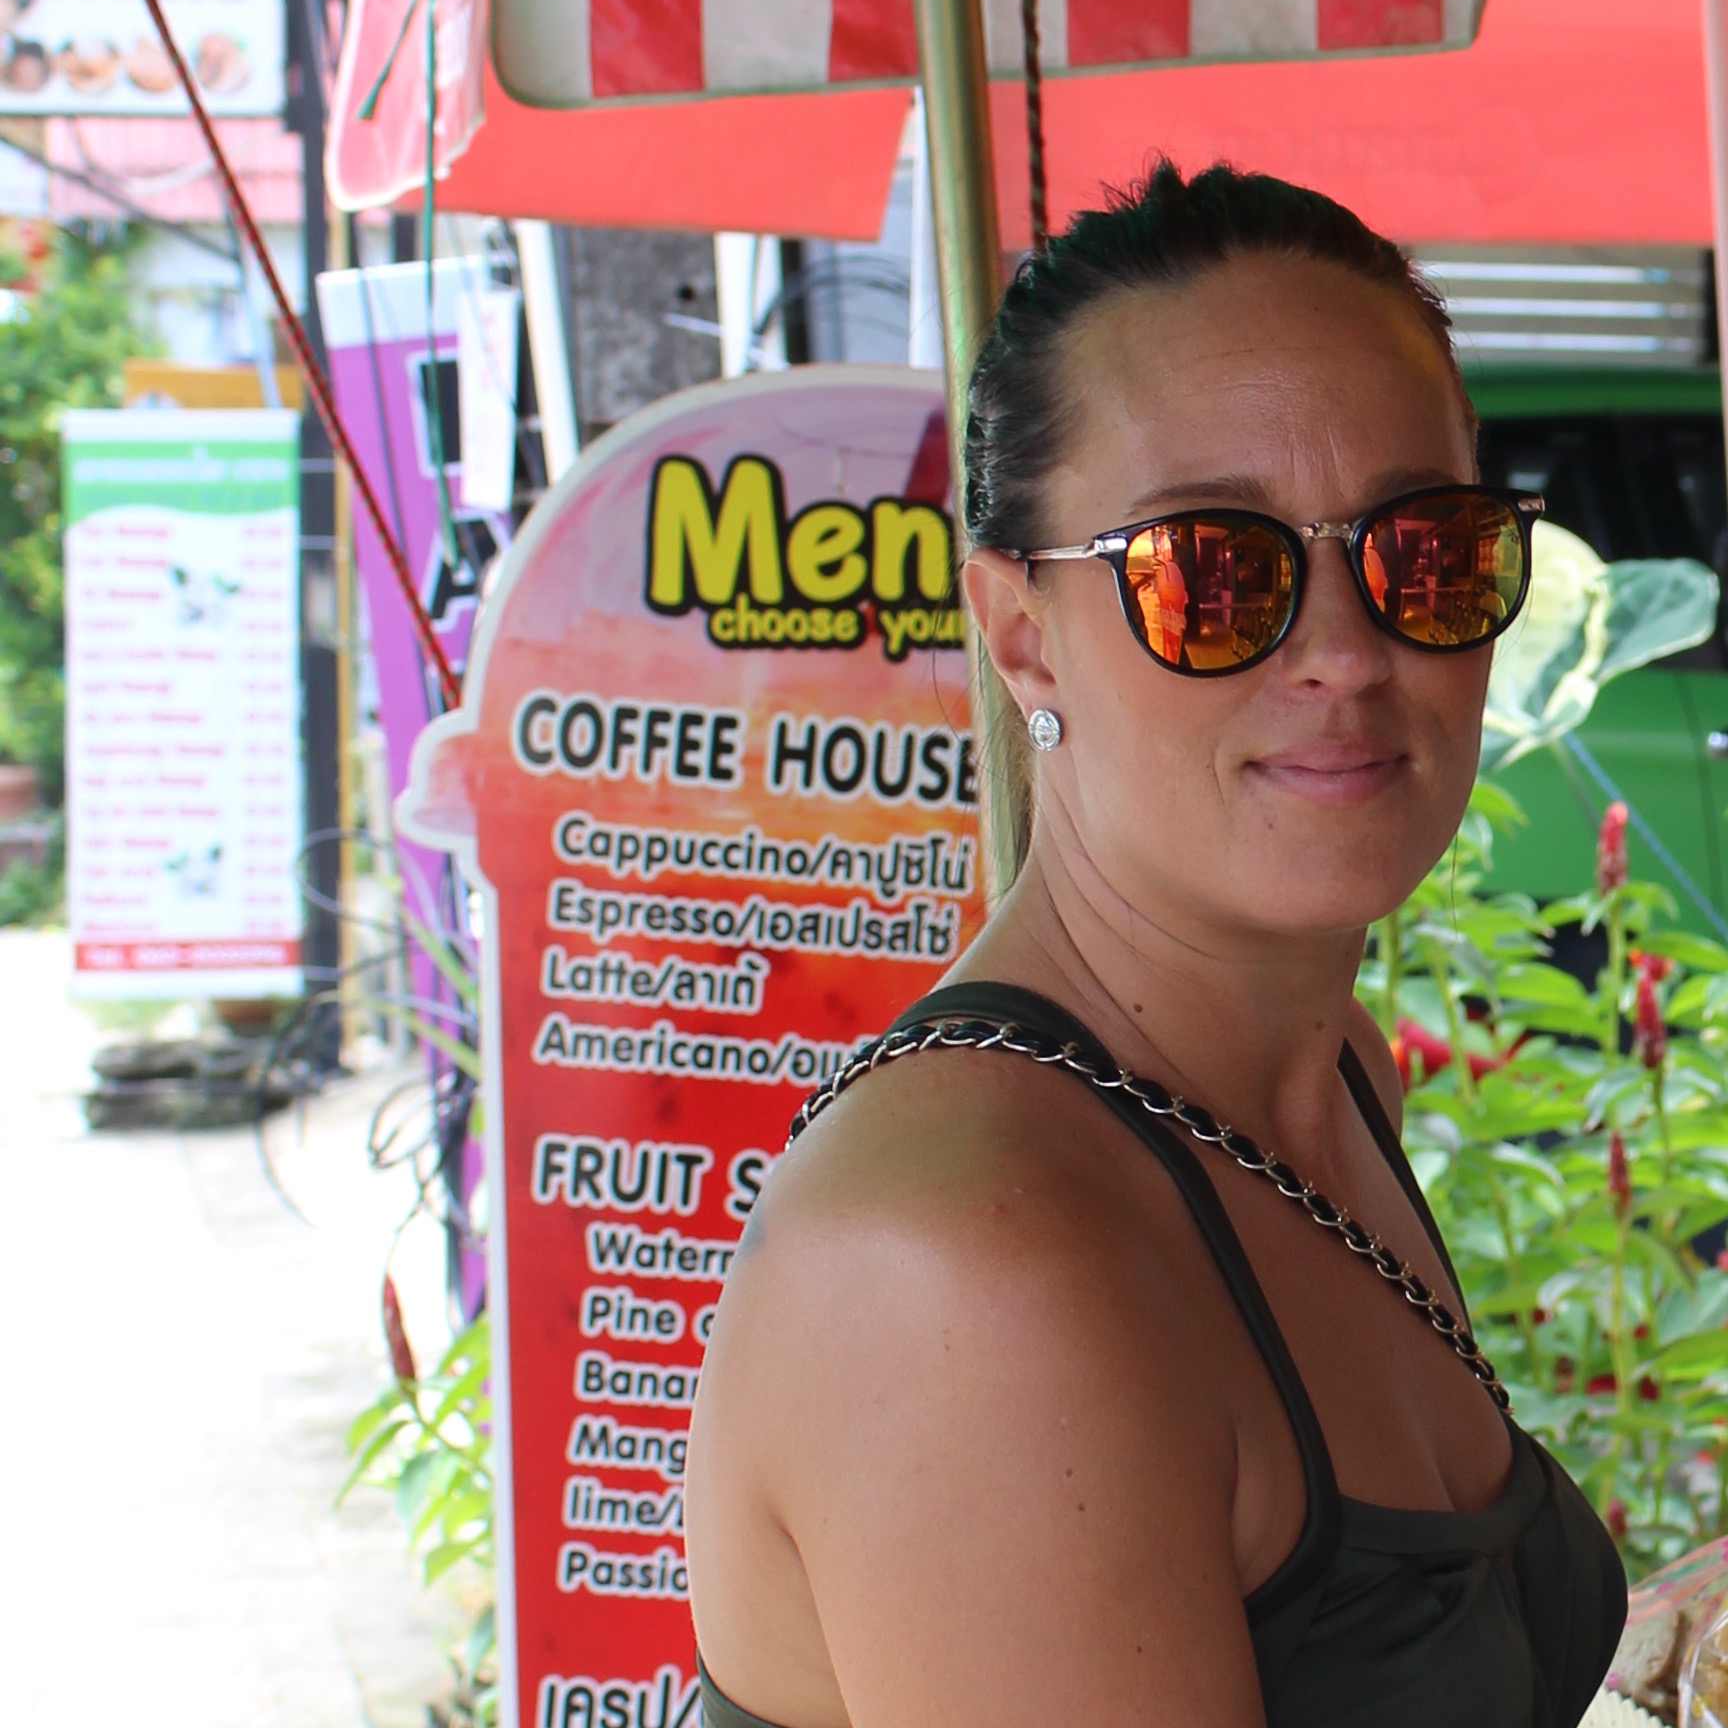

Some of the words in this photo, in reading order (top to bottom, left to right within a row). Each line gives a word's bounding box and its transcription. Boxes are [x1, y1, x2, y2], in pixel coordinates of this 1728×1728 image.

[648, 457, 950, 608] Men
[709, 590, 859, 642] choose
[518, 695, 738, 781] COFFEE
[769, 718, 979, 805] HOUSE
[539, 1140, 704, 1208] FRUIT
[731, 1156, 765, 1214] S
[588, 1294, 676, 1336] Pine
[569, 1483, 685, 1529] lime/
